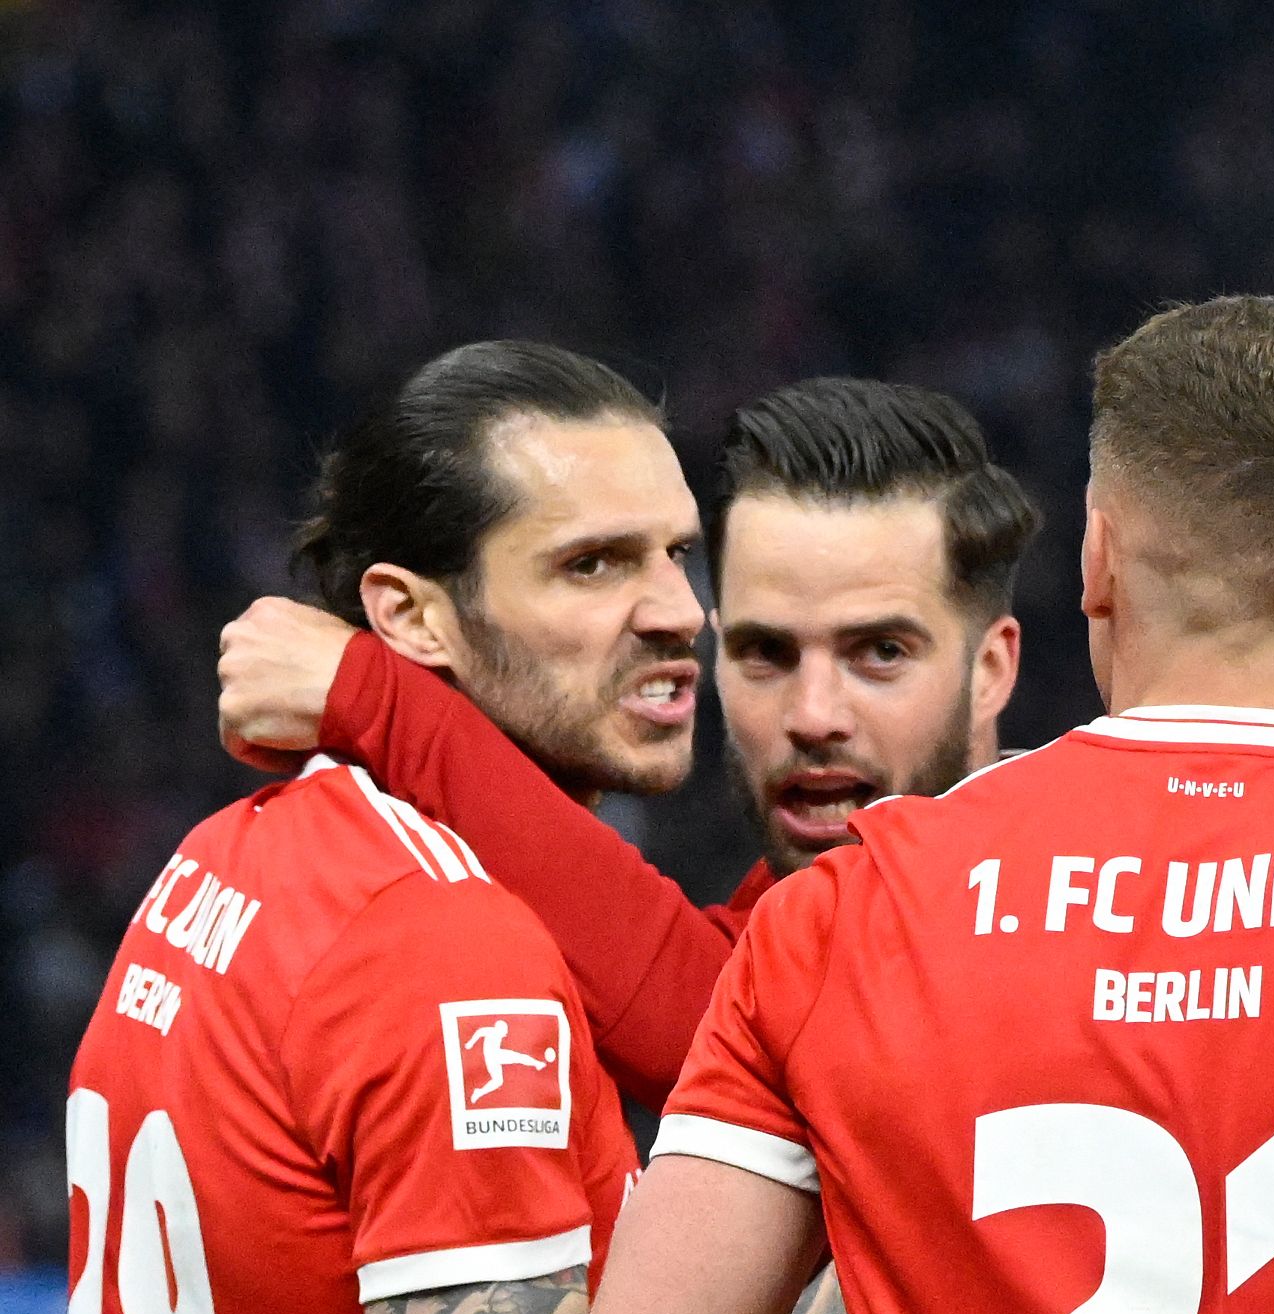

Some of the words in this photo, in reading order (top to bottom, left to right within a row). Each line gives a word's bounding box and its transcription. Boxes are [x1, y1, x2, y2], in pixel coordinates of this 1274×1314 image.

[968, 858, 1019, 936] 1.
[1045, 855, 1142, 934] FC
[1092, 965, 1263, 1024] BERLIN
[466, 1119, 560, 1135] BUNDESLIGA
